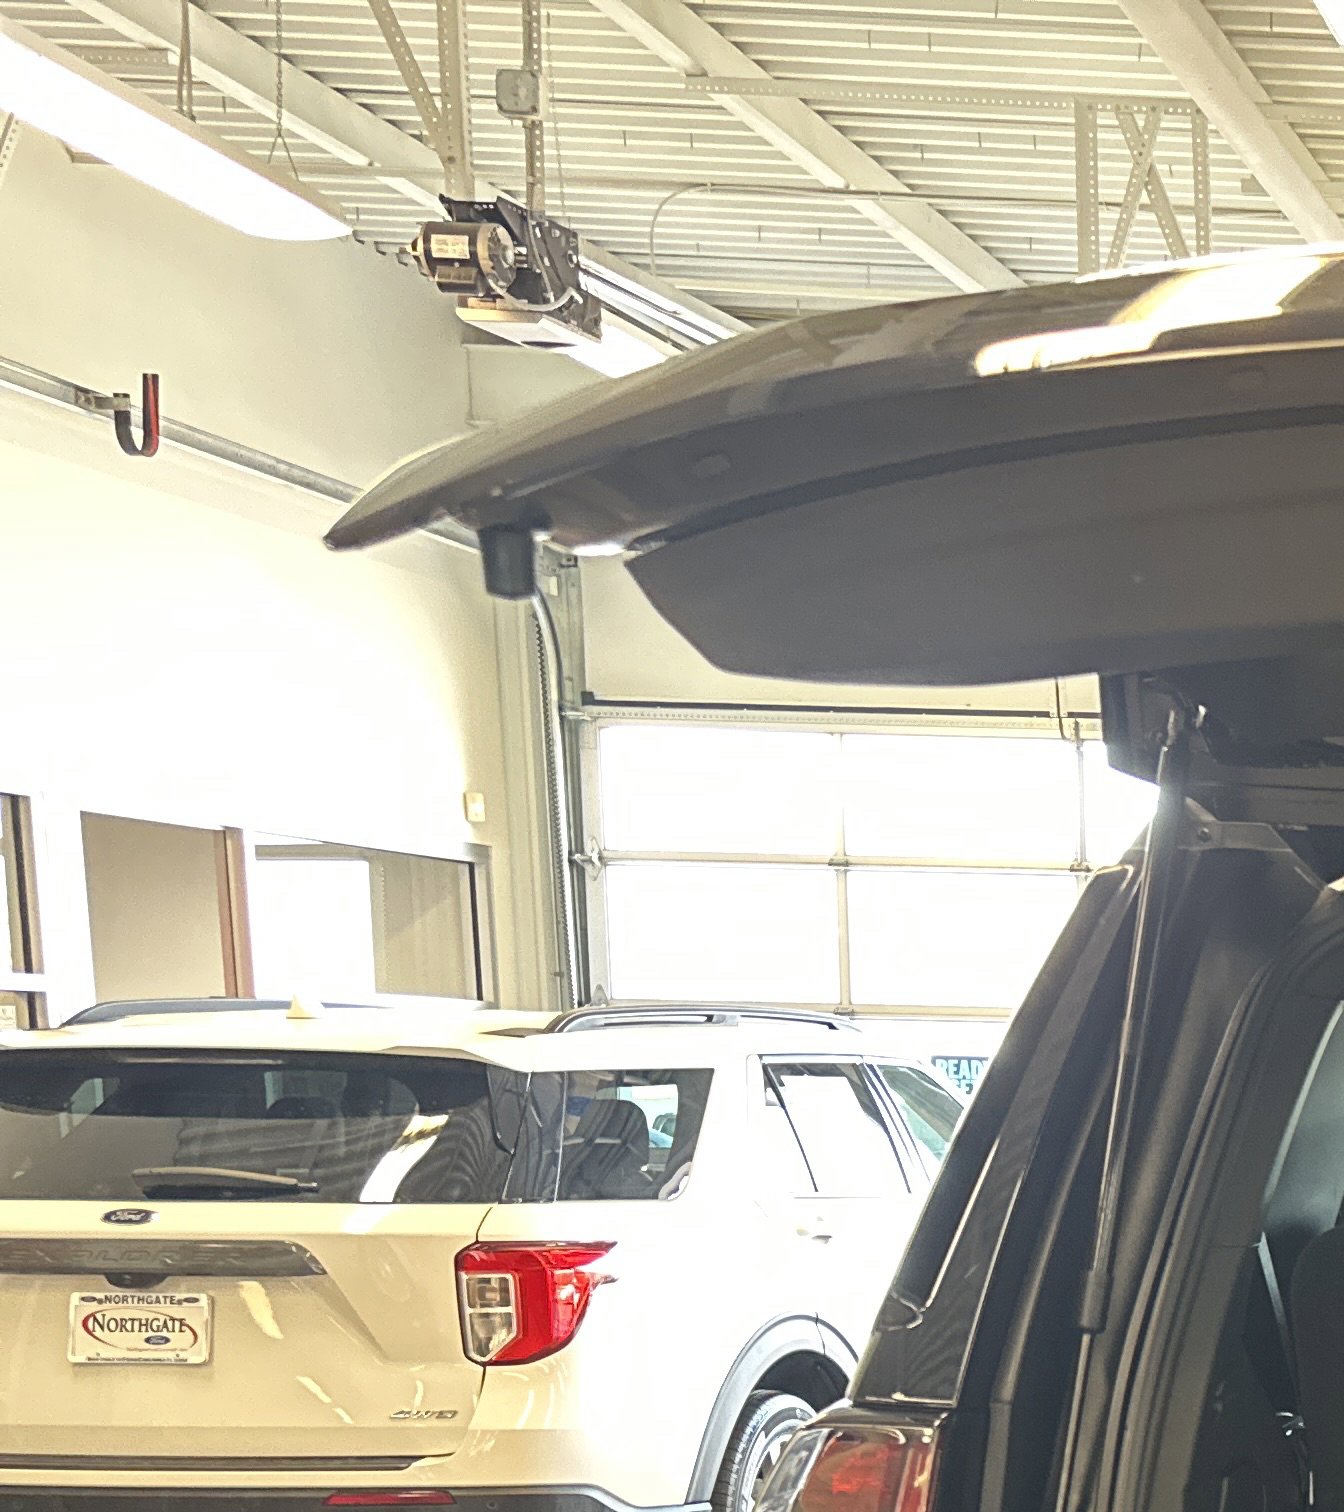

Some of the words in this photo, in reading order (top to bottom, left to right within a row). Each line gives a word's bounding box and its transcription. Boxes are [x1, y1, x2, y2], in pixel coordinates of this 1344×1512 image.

[935, 1058, 988, 1080] READ
[110, 1209, 146, 1222] Ford
[104, 1294, 176, 1305] NORTHGATE
[91, 1313, 187, 1333] NORTHGATE
[390, 1409, 459, 1420] 4WD
